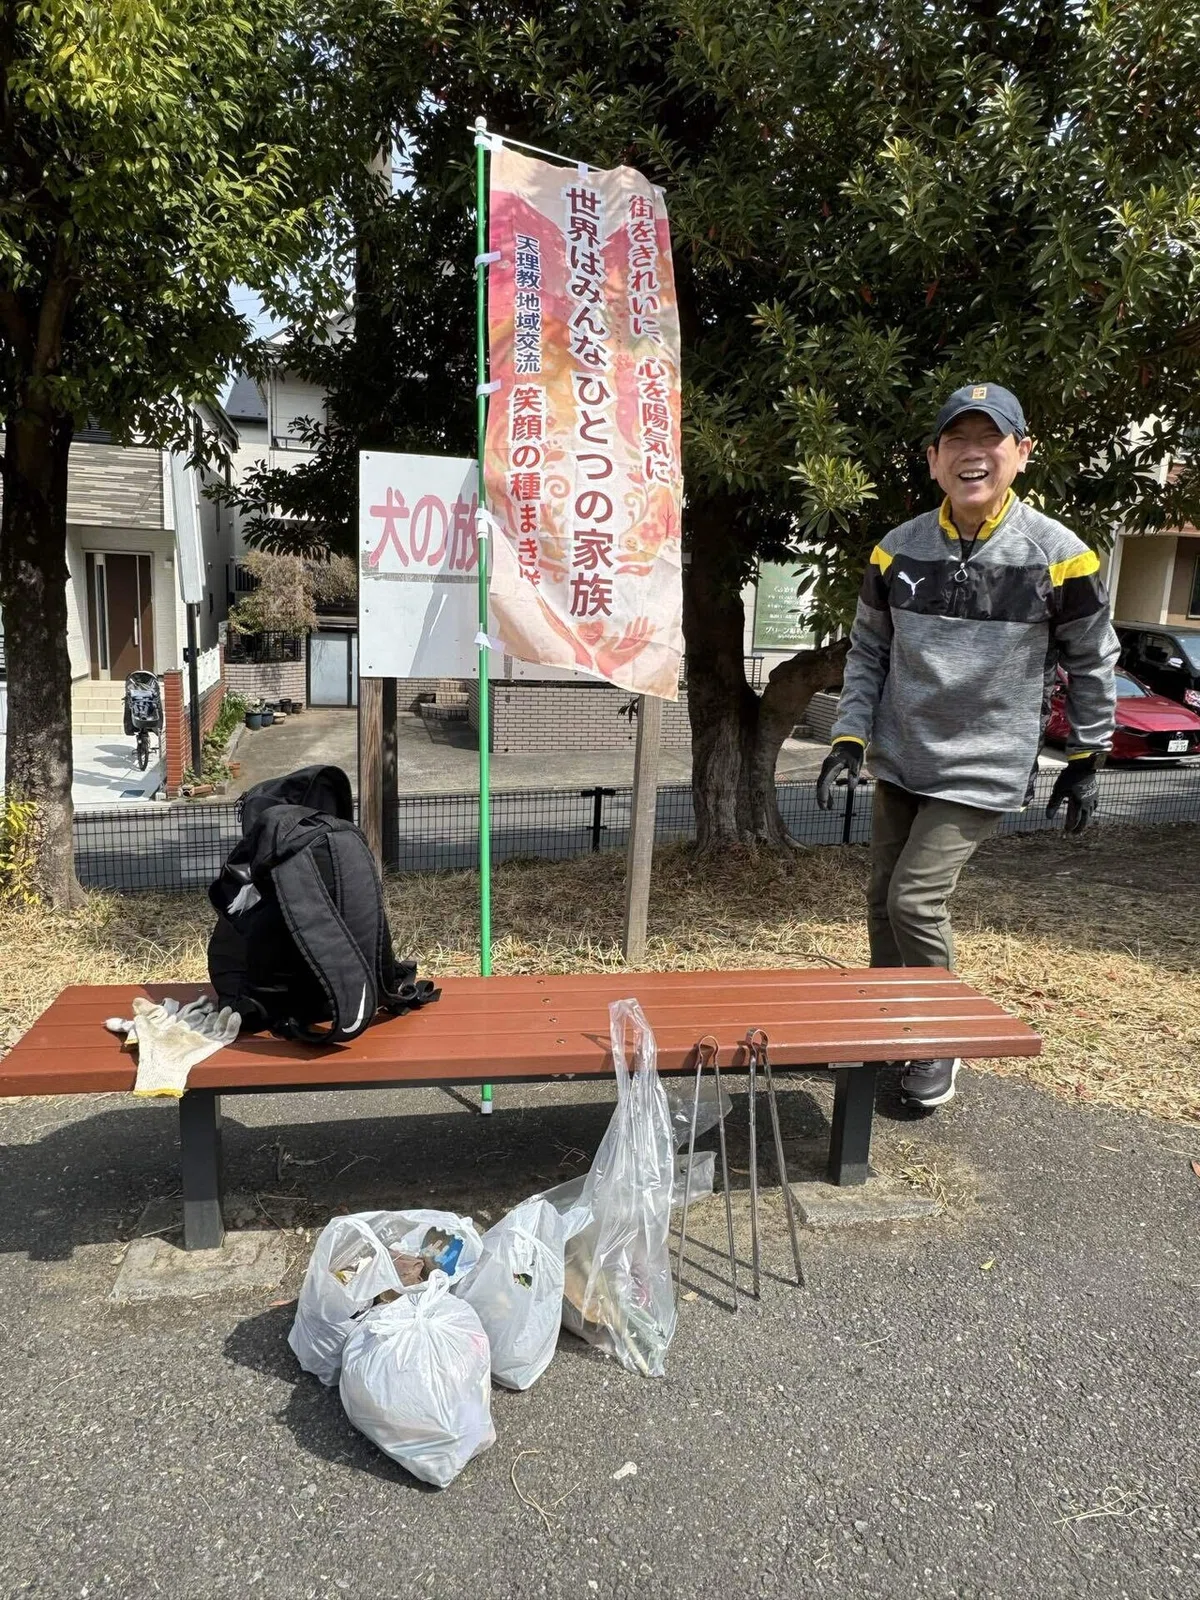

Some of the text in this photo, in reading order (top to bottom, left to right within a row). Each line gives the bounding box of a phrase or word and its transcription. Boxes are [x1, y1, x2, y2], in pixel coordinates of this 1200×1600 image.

[516, 234, 541, 373] 天理教地域交流
[566, 187, 614, 617] 世界はみんなひとつの家族
[638, 358, 671, 484] 心を陽気に
